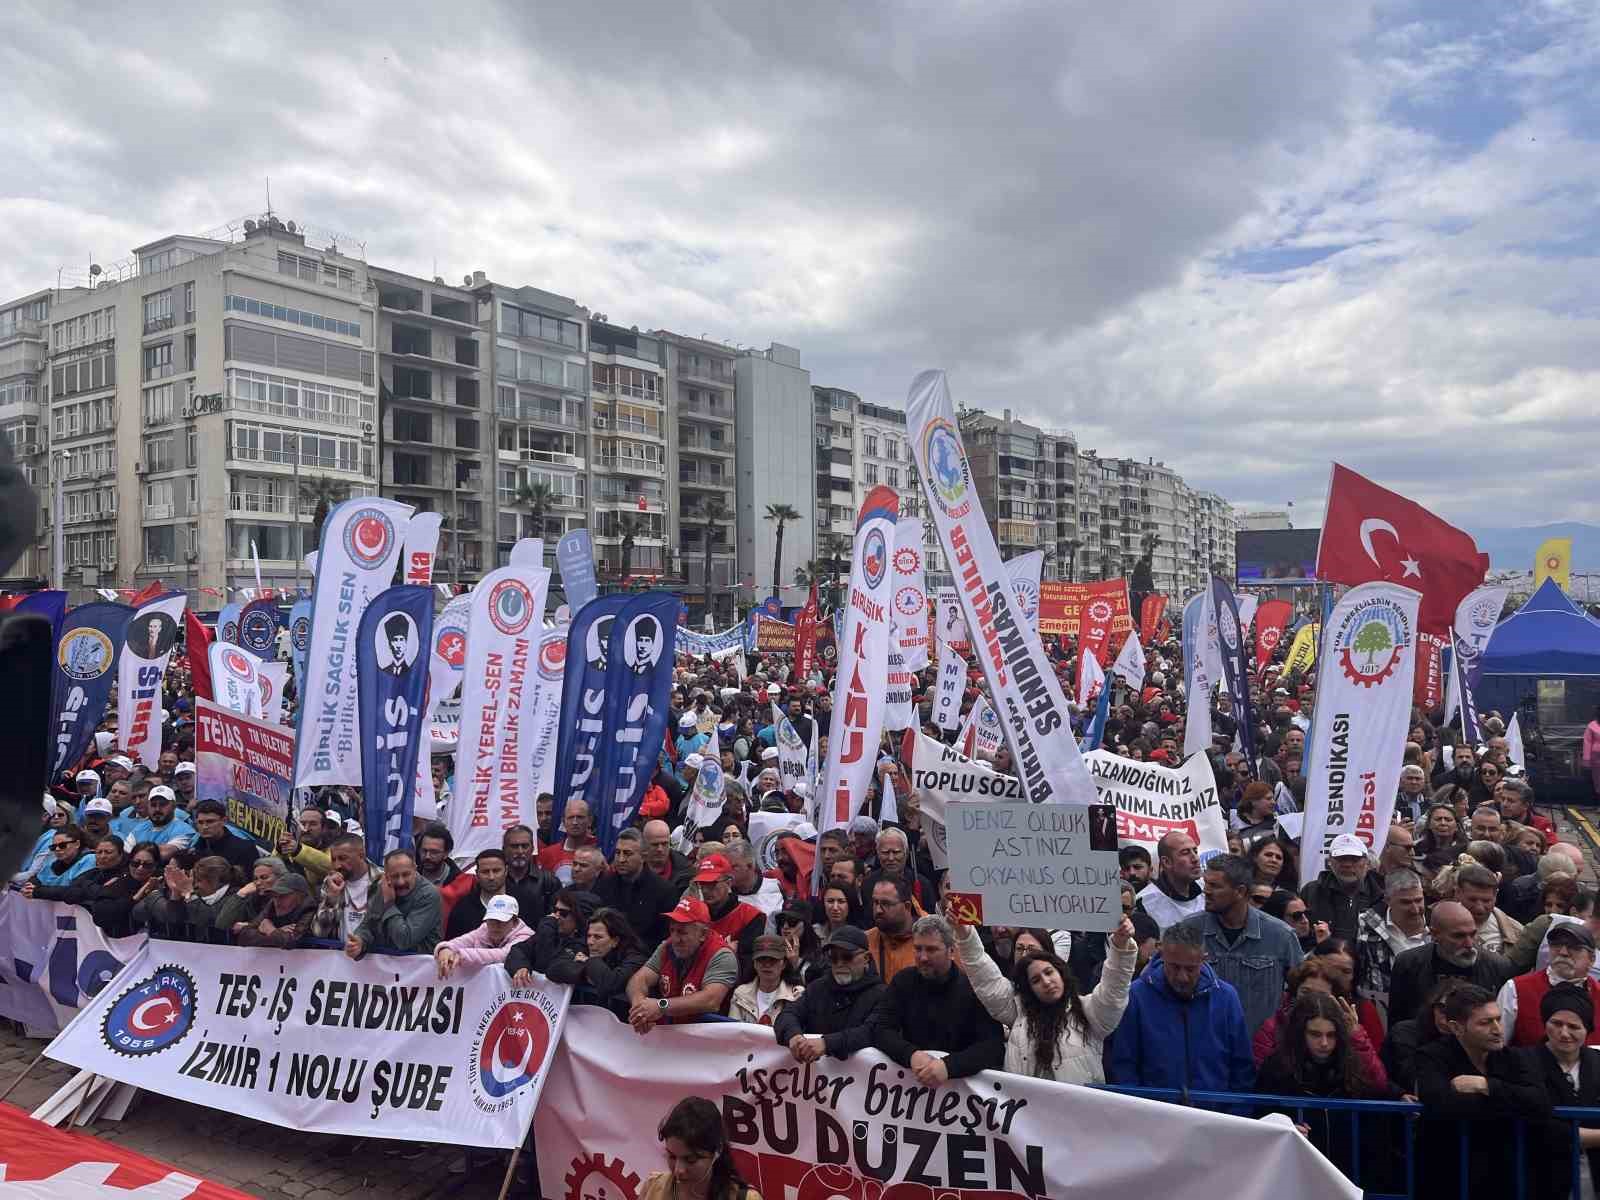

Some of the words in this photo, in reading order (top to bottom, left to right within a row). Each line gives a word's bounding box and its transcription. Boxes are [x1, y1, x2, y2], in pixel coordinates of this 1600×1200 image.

[313, 700, 338, 772] BİRLİK
[338, 572, 357, 615] SEN
[507, 638, 530, 710] ZAMANI
[986, 580, 1062, 738] SENDİKASI
[1359, 664, 1380, 674] 2017
[478, 652, 503, 761] YEREL-SEN
[501, 721, 520, 776] BİRLİK
[915, 770, 975, 793] TOPLU
[1085, 758, 1193, 797] AZANDIĞIMIZ
[1326, 713, 1350, 826] SENDİKASI
[470, 762, 494, 828] BİRLİK
[1027, 811, 1088, 833] OLDUK
[1353, 771, 1377, 850] UBESİ
[969, 865, 1055, 887] OKYANUS
[1062, 866, 1121, 887] OLDUK
[214, 965, 298, 1035] TES-İŞ
[305, 972, 465, 1036] SENDİKASI
[114, 1029, 155, 1048] 1952
[177, 1030, 262, 1090] İZMİR
[268, 1051, 281, 1092] 1
[286, 1052, 368, 1104] NOLU
[370, 1059, 454, 1120] ŞUBE
[734, 1054, 856, 1110] işçiler
[863, 1062, 1029, 1135] birleşir
[722, 1094, 801, 1156] BU
[814, 1109, 1049, 1199] DÜZEN
